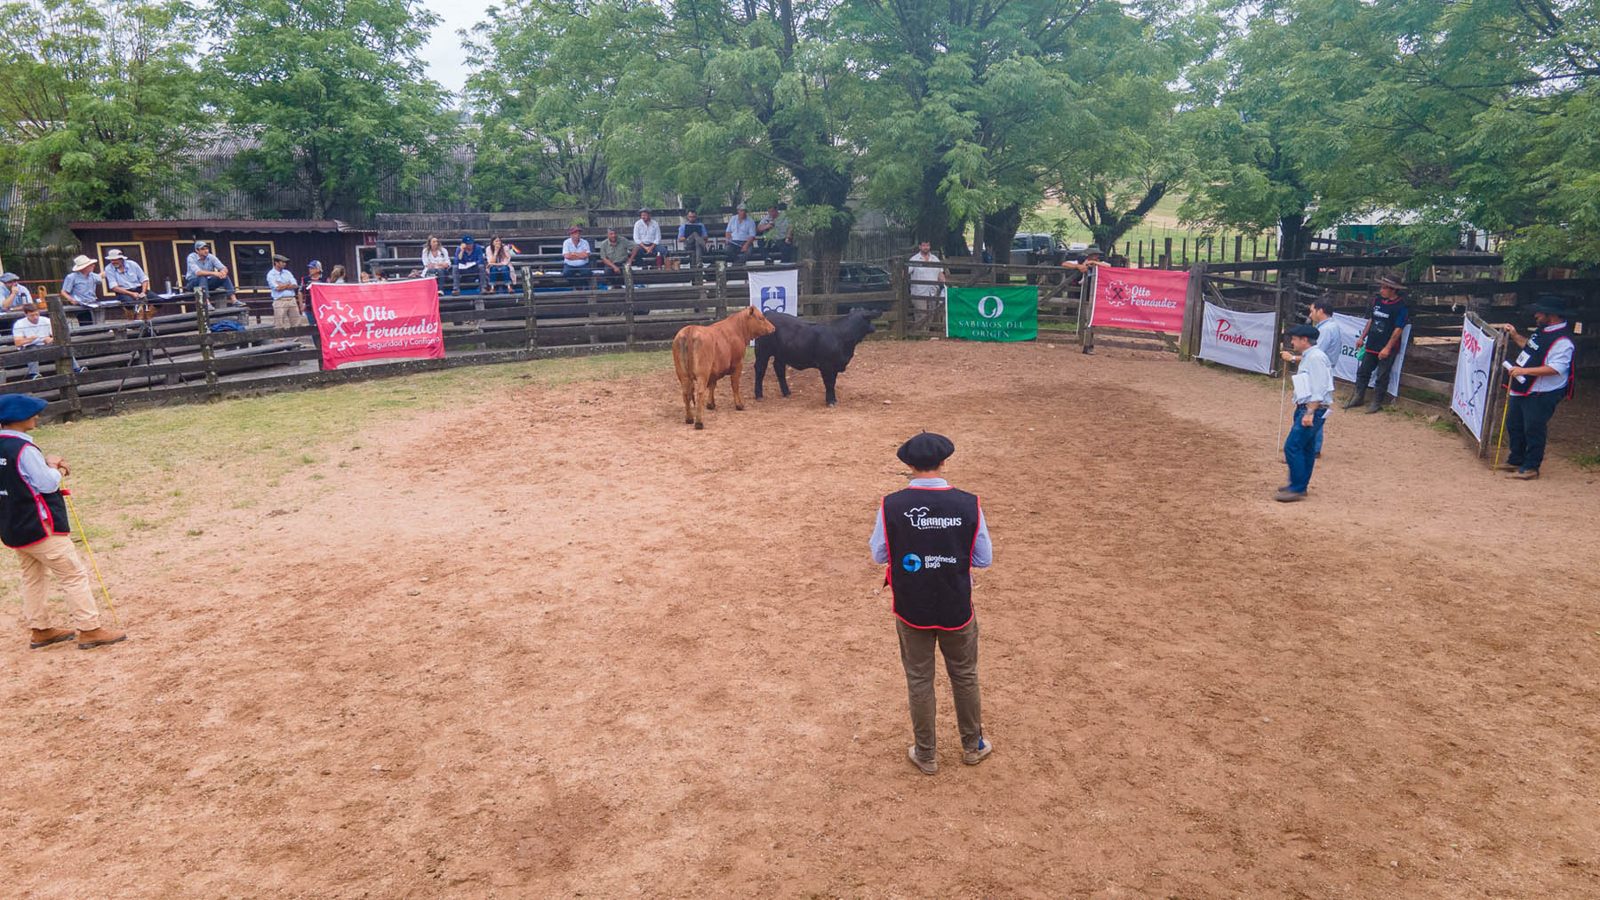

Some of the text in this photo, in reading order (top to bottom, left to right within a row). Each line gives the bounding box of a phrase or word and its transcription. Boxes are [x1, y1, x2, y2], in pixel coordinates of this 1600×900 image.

[1131, 285, 1151, 297] Otto
[363, 305, 398, 322] Otto
[971, 330, 1010, 338] ORIGEN
[1216, 319, 1259, 348] Providean
[367, 339, 402, 350] Seguridad
[920, 517, 962, 528] BRANGUS
